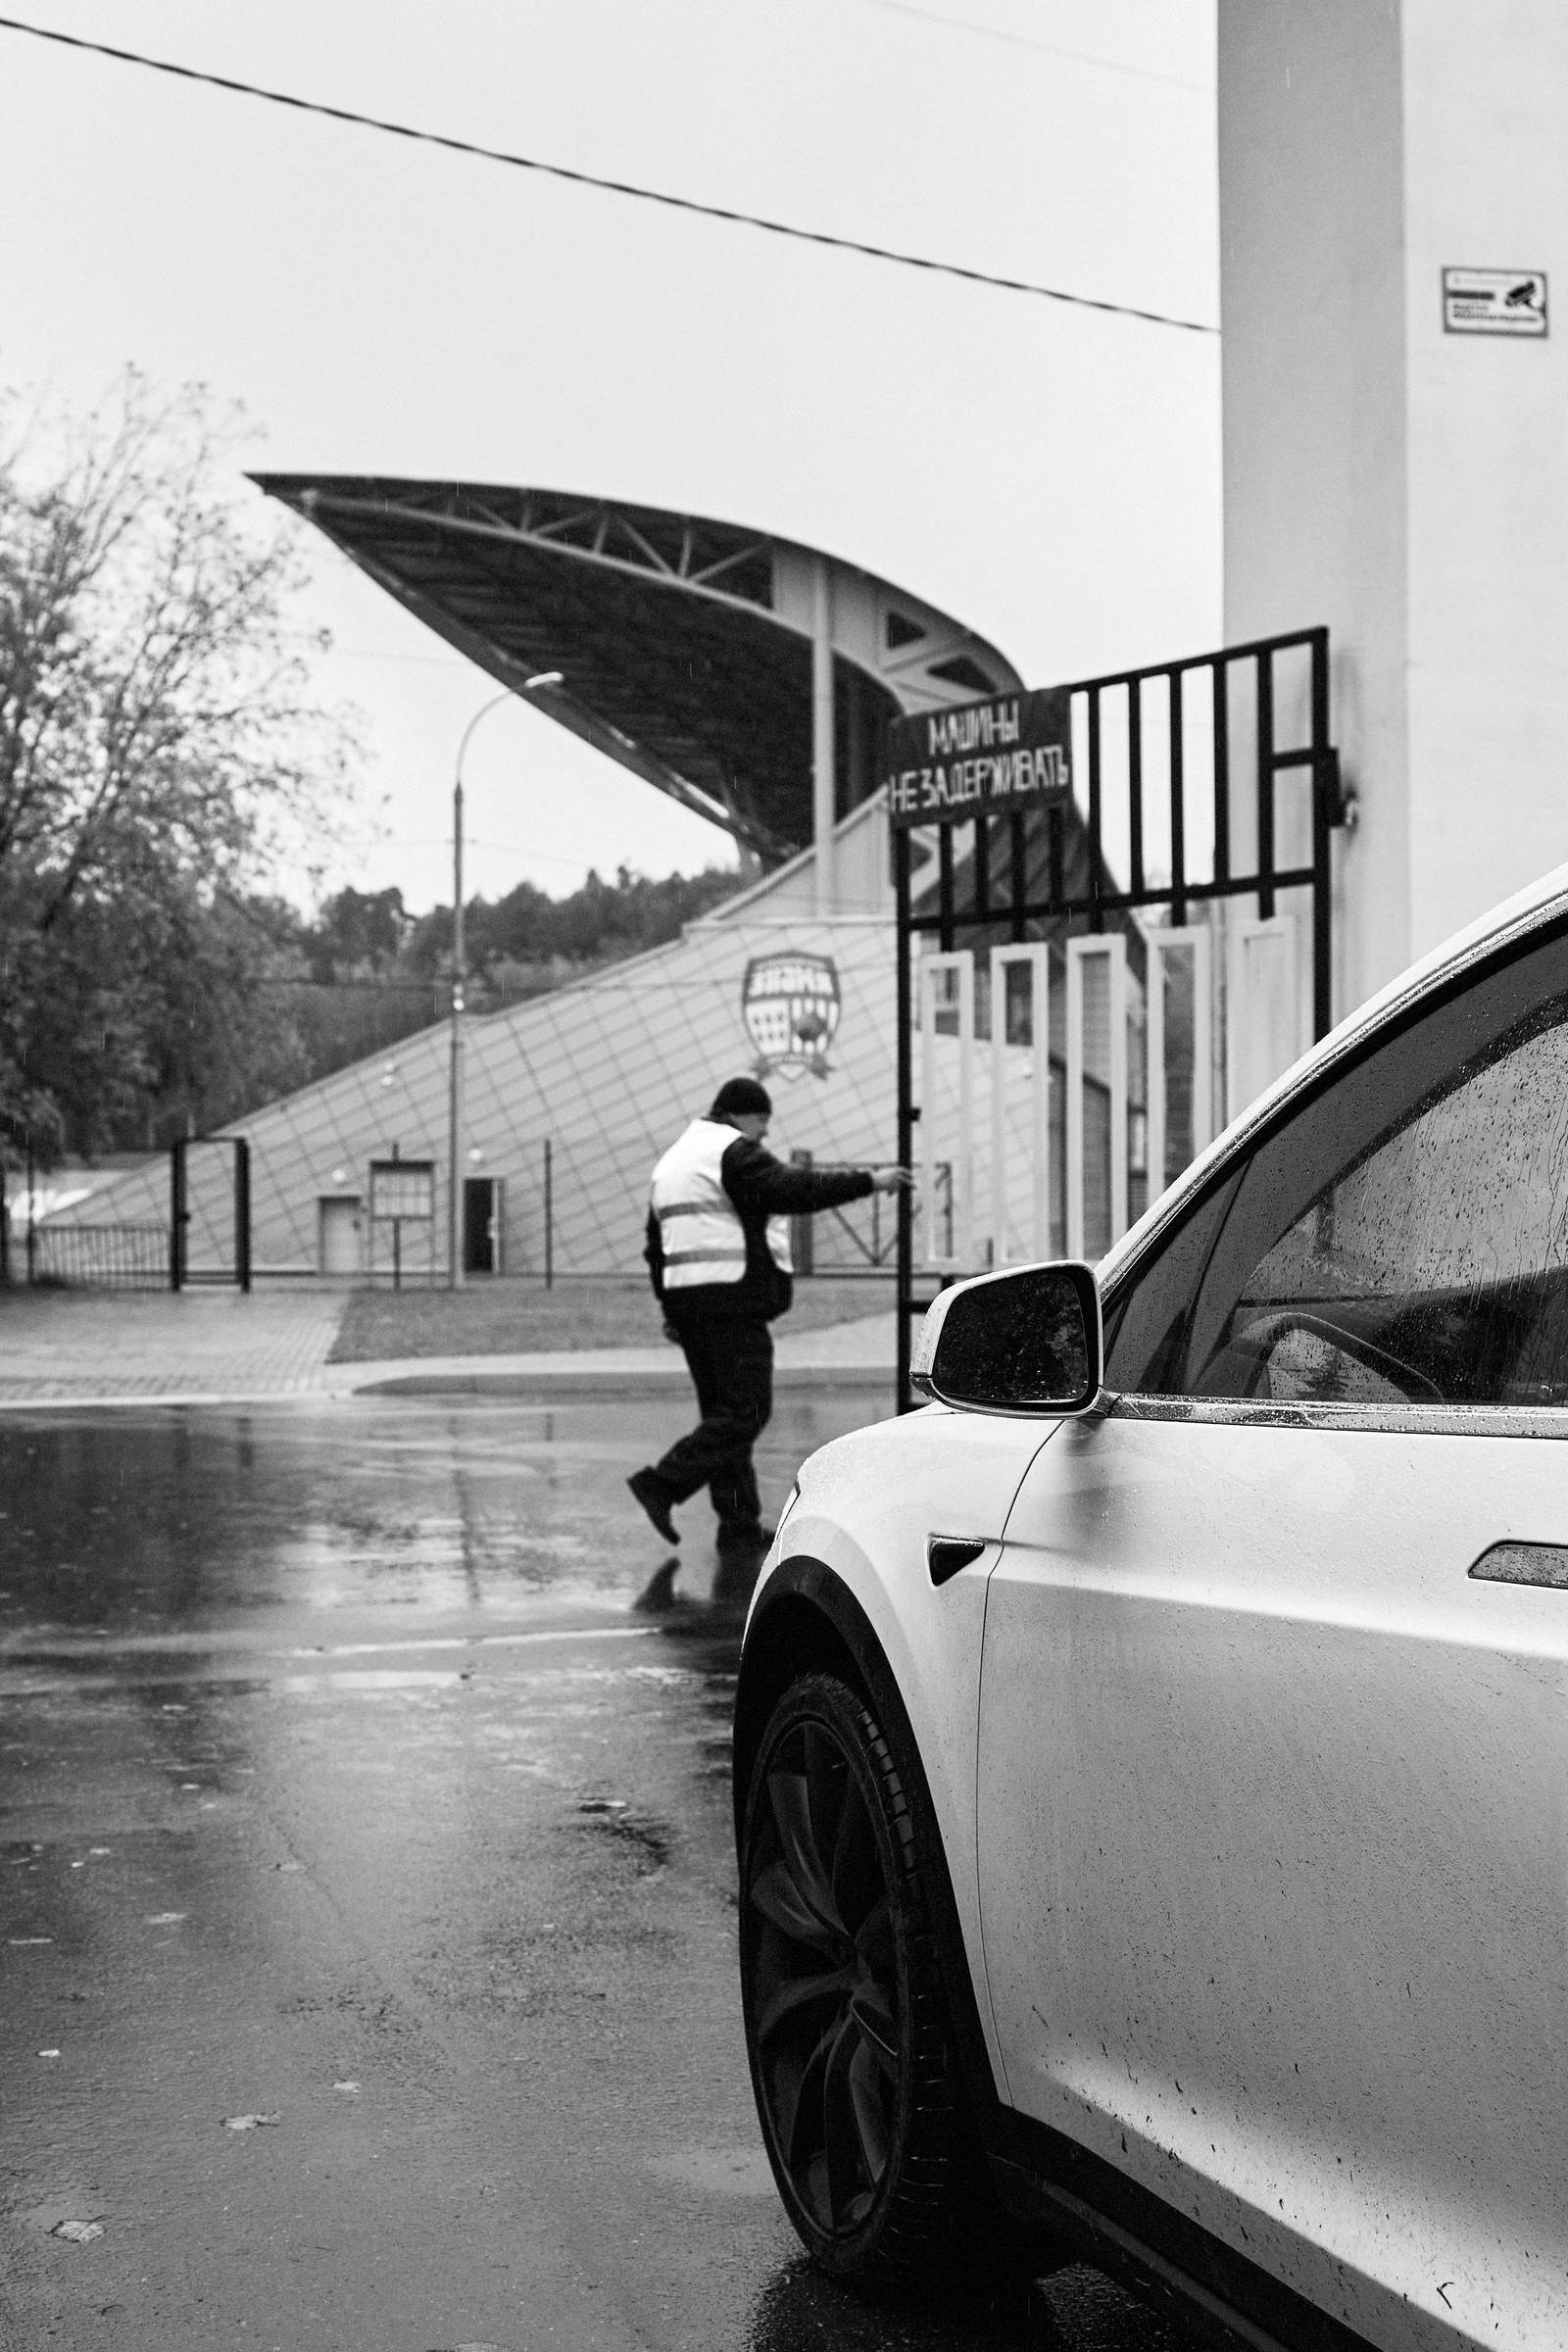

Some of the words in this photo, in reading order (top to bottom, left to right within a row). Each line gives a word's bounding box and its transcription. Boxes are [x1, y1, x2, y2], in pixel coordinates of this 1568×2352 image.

[929, 701, 1019, 756] МАШИНЫ
[890, 771, 918, 812] НЕ
[921, 745, 1069, 808] ЗАДЕРЖИВАТЬ
